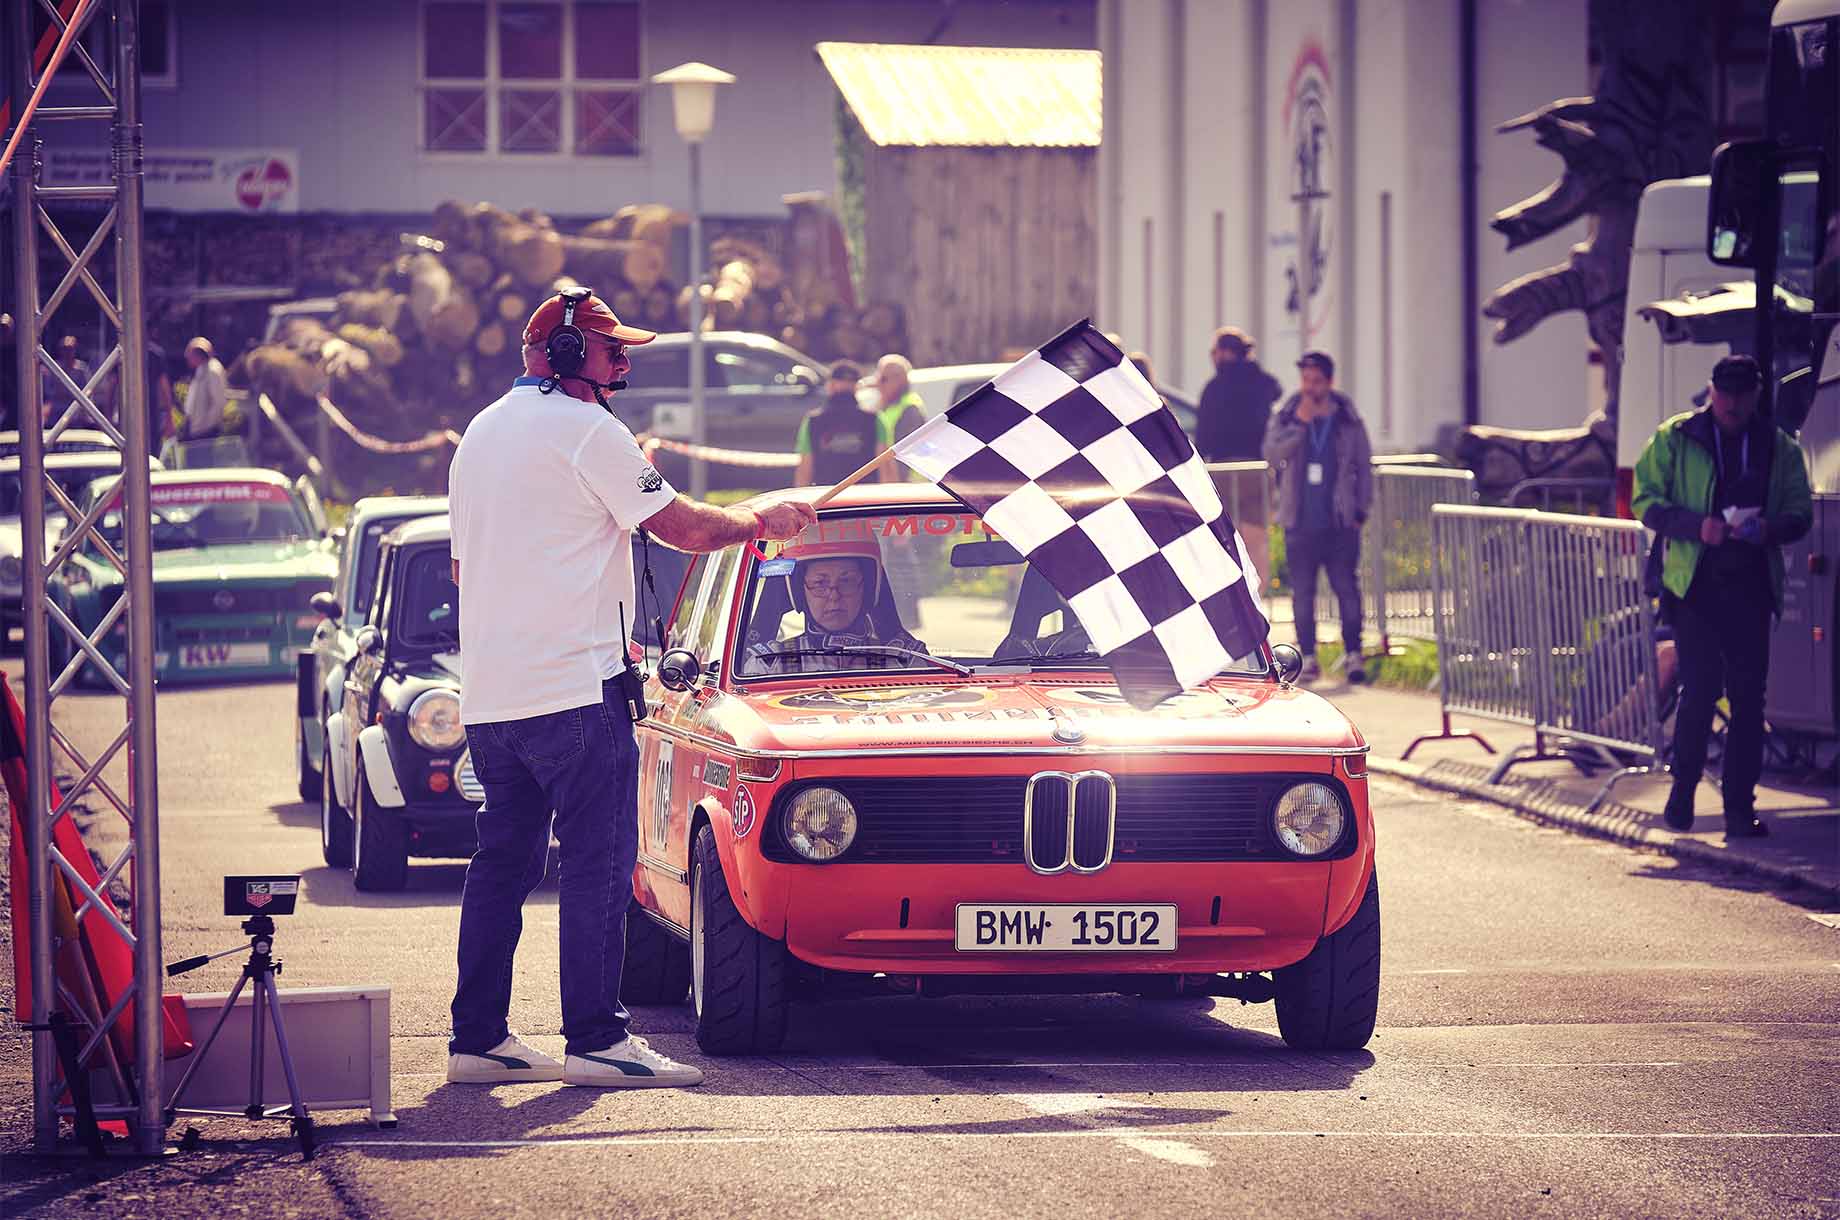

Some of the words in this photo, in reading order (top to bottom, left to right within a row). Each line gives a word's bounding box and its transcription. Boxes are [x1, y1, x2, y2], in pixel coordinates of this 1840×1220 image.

[734, 791, 749, 827] STP
[976, 910, 1046, 945] BMW
[1071, 910, 1160, 945] 1502
